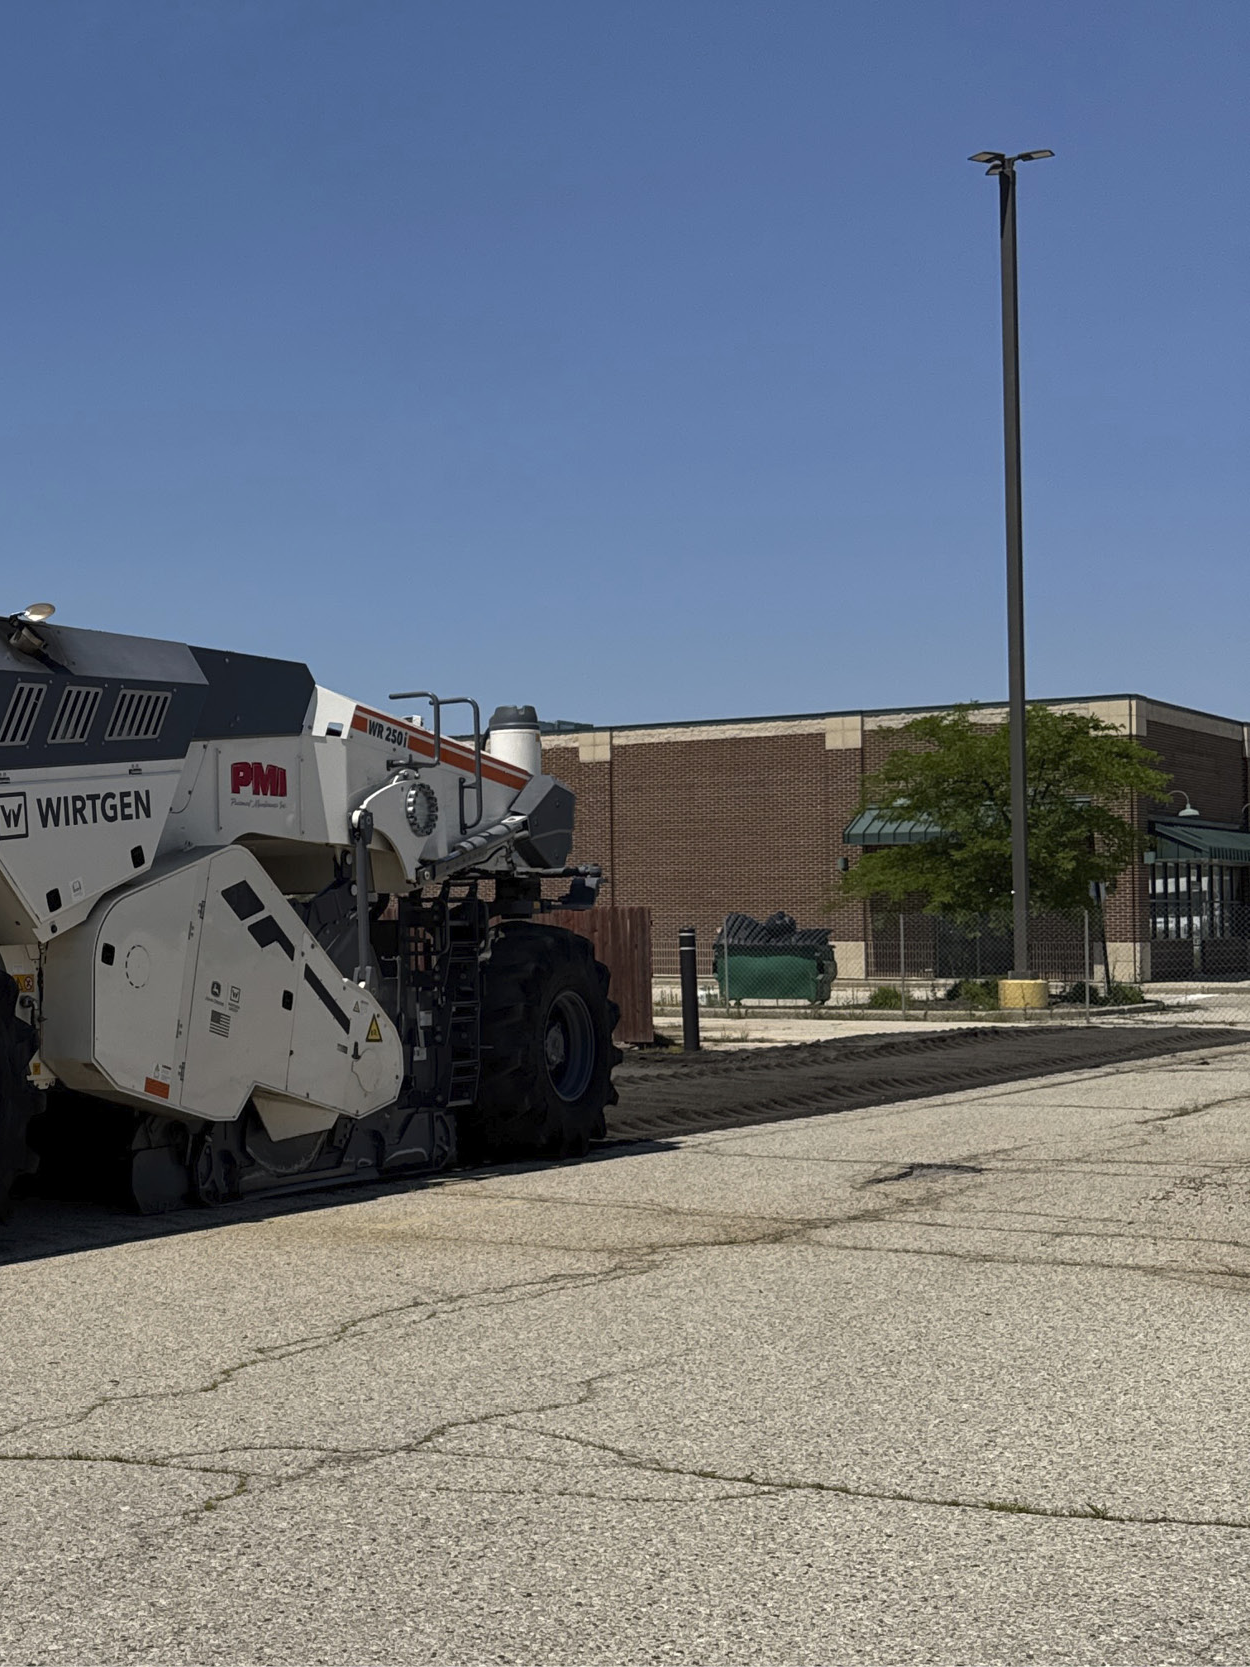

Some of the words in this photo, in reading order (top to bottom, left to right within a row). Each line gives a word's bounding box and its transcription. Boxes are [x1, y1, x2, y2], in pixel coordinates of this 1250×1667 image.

[368, 719, 384, 740] WR
[230, 761, 287, 798] PMI
[36, 789, 151, 828] WIRTGEN
